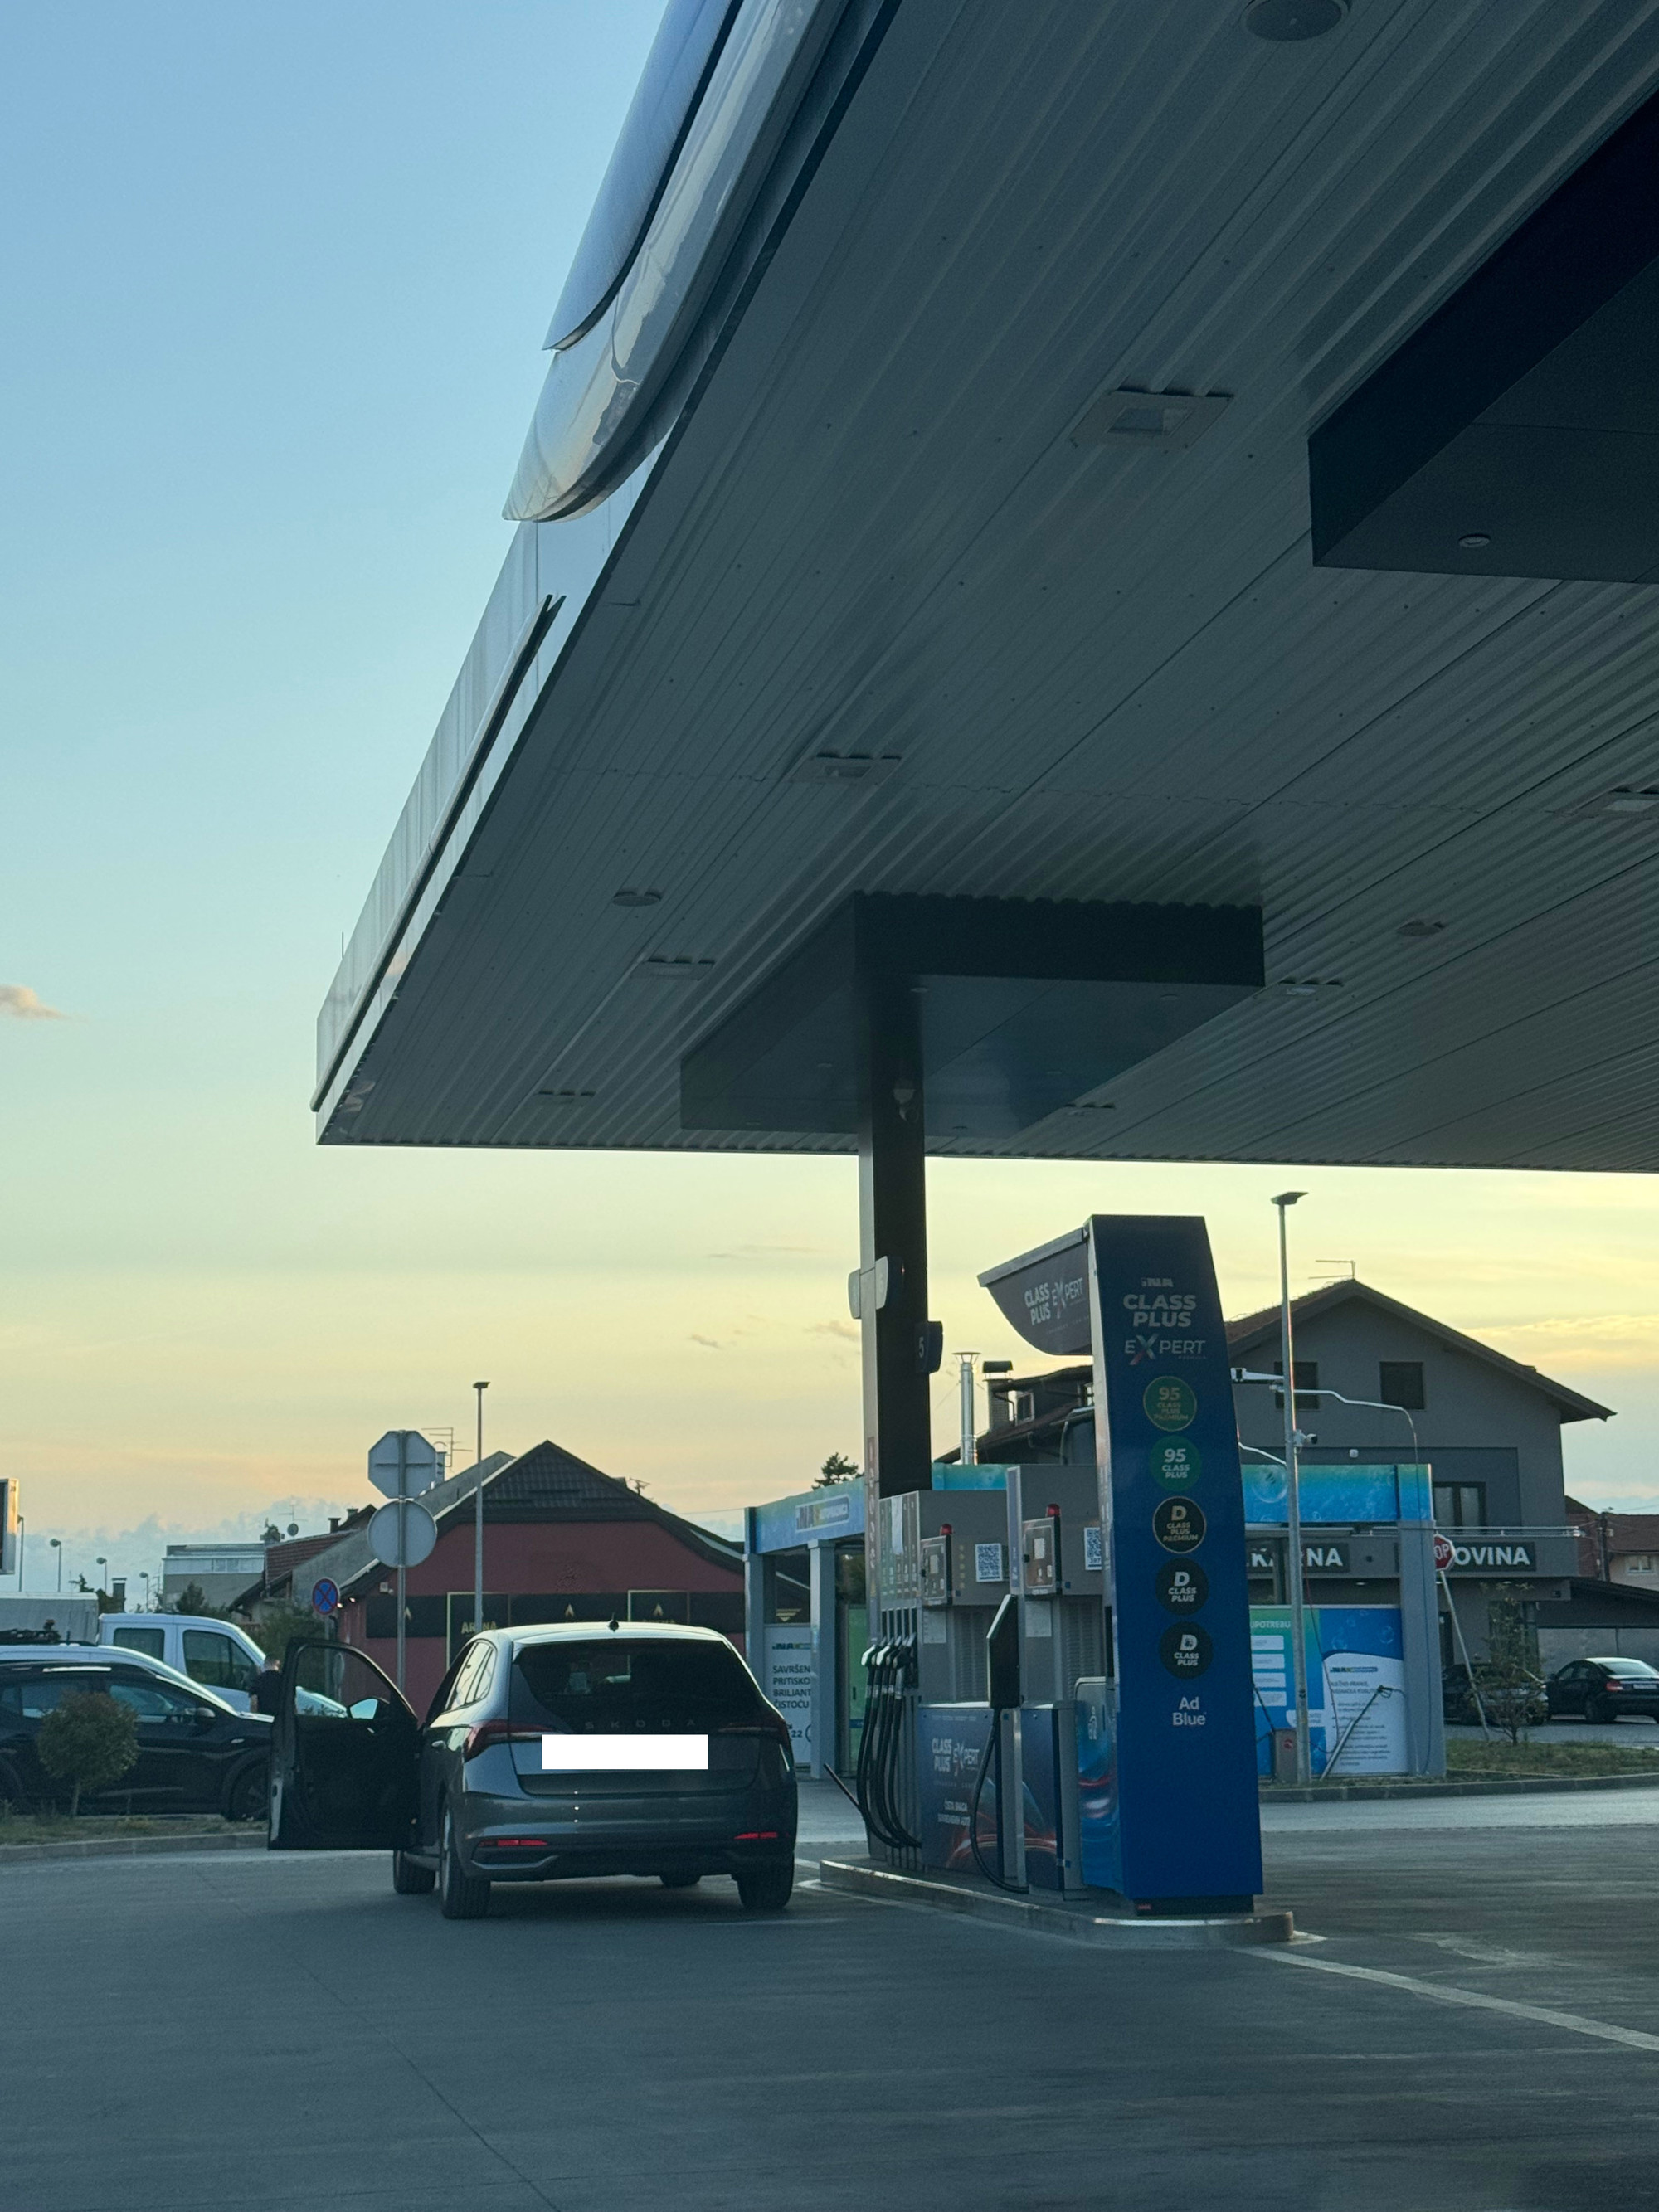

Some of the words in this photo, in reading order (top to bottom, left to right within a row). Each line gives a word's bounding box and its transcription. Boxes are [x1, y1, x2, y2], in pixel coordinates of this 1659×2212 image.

[1024, 1282, 1050, 1308] CLASS
[1051, 1277, 1083, 1320] EXPERT
[1123, 1294, 1197, 1310] CLASS
[1030, 1301, 1052, 1326] PLUS
[1133, 1311, 1192, 1328] PLUS
[1125, 1334, 1206, 1366] EXPERT
[1158, 1387, 1180, 1402] 95
[1164, 1448, 1187, 1464] 95
[1162, 1464, 1190, 1472] CLASS
[1171, 1505, 1187, 1521] D
[1433, 1544, 1450, 1560] OP
[1455, 1546, 1530, 1566] OVINA
[1174, 1571, 1190, 1587] D
[1168, 1587, 1197, 1595] CLASS
[461, 1621, 497, 1634] ARNA
[1180, 1634, 1198, 1651] D
[773, 1677, 810, 1685] PRITISKO
[1178, 1696, 1199, 1711] Ad
[1172, 1712, 1206, 1726] Blue
[932, 1738, 952, 1754] CLASS
[934, 1755, 951, 1772] PLUS
